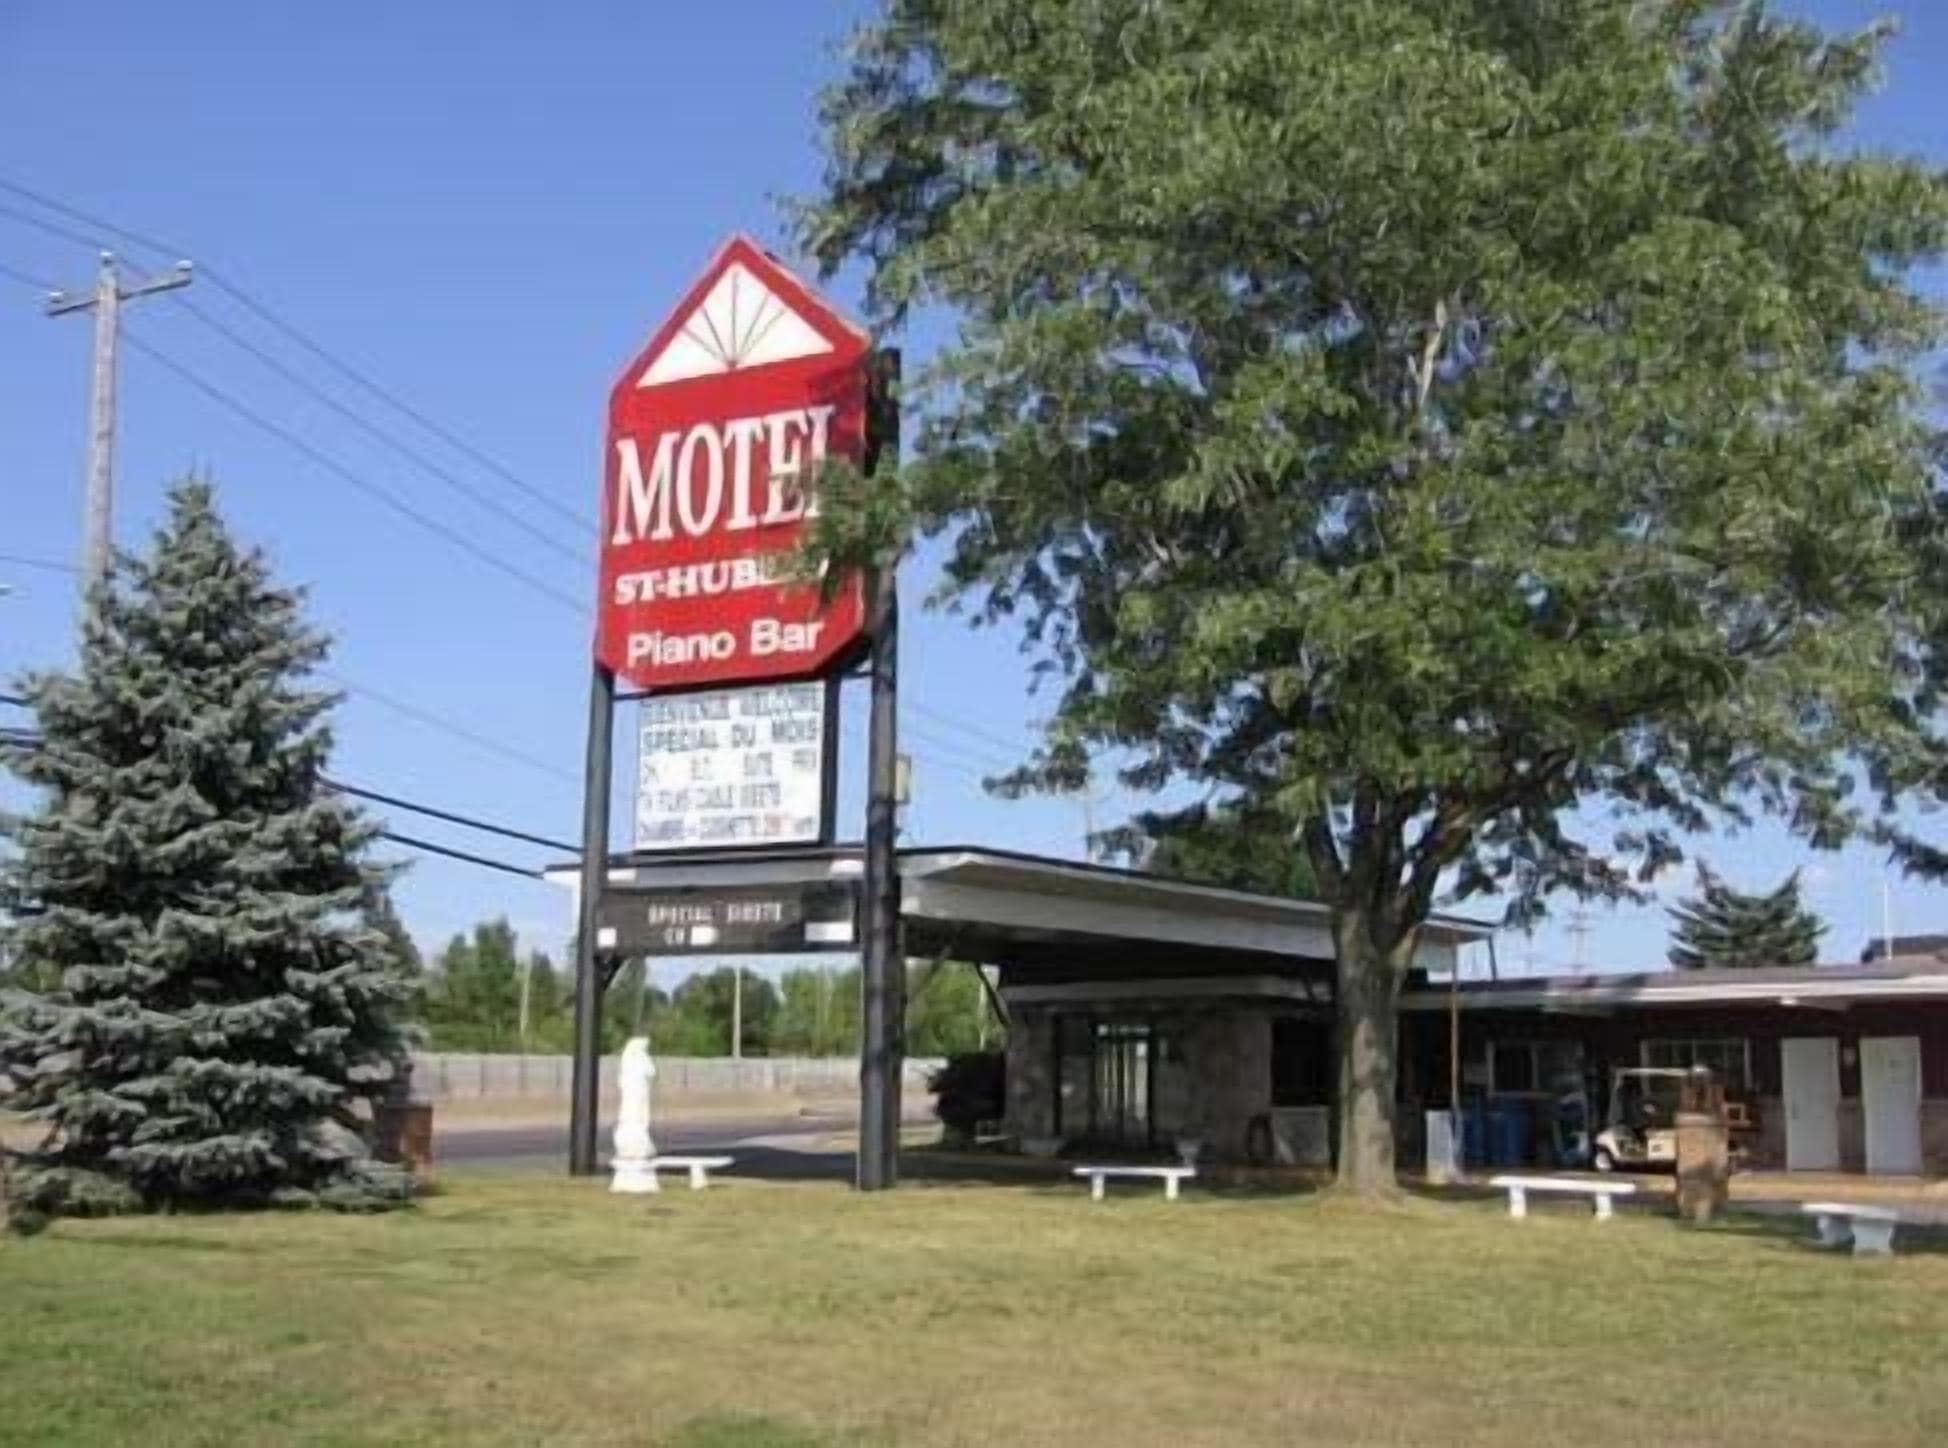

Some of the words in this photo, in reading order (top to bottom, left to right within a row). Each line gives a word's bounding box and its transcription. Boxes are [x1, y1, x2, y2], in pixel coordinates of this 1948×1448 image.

[612, 404, 836, 545] MOTEL
[614, 556, 830, 605] ST-HUB
[627, 629, 736, 668] Piano
[750, 617, 825, 655] Bar
